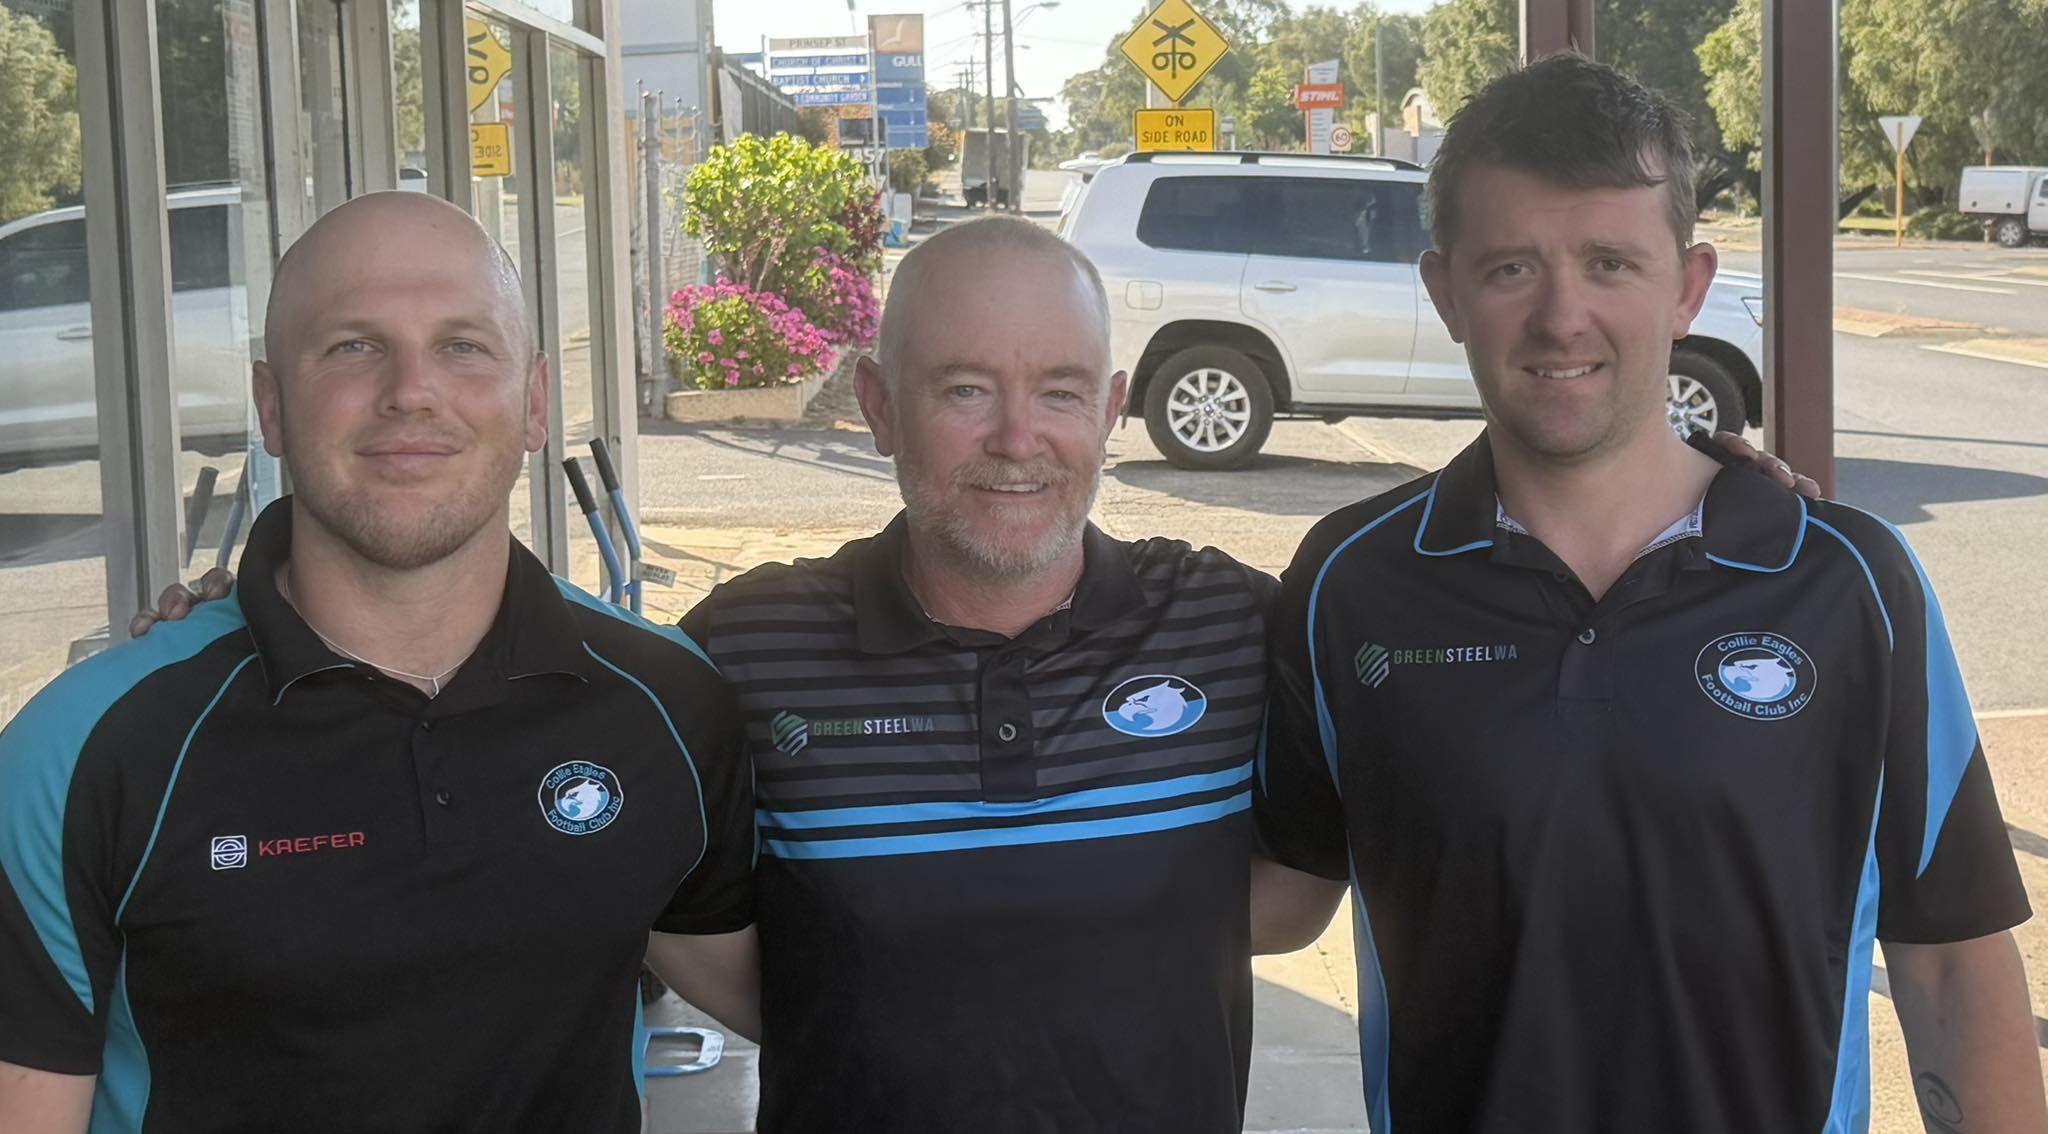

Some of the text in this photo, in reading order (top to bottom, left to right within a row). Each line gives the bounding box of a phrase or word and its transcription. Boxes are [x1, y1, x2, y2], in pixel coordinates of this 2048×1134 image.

[892, 56, 923, 67] GULL
[773, 75, 850, 86] BAPTIST CHURCH
[1300, 90, 1340, 102] STIHL
[1165, 115, 1184, 127] ON
[1142, 130, 1207, 143] SIDE ROAD
[1335, 131, 1348, 142] 60
[1717, 636, 1803, 665] Collie Eagles
[1702, 673, 1808, 716] Football Club Inc
[545, 763, 607, 789] Collie Eagles
[548, 796, 620, 832] Football Club Inc
[258, 831, 365, 857] KAEFER
